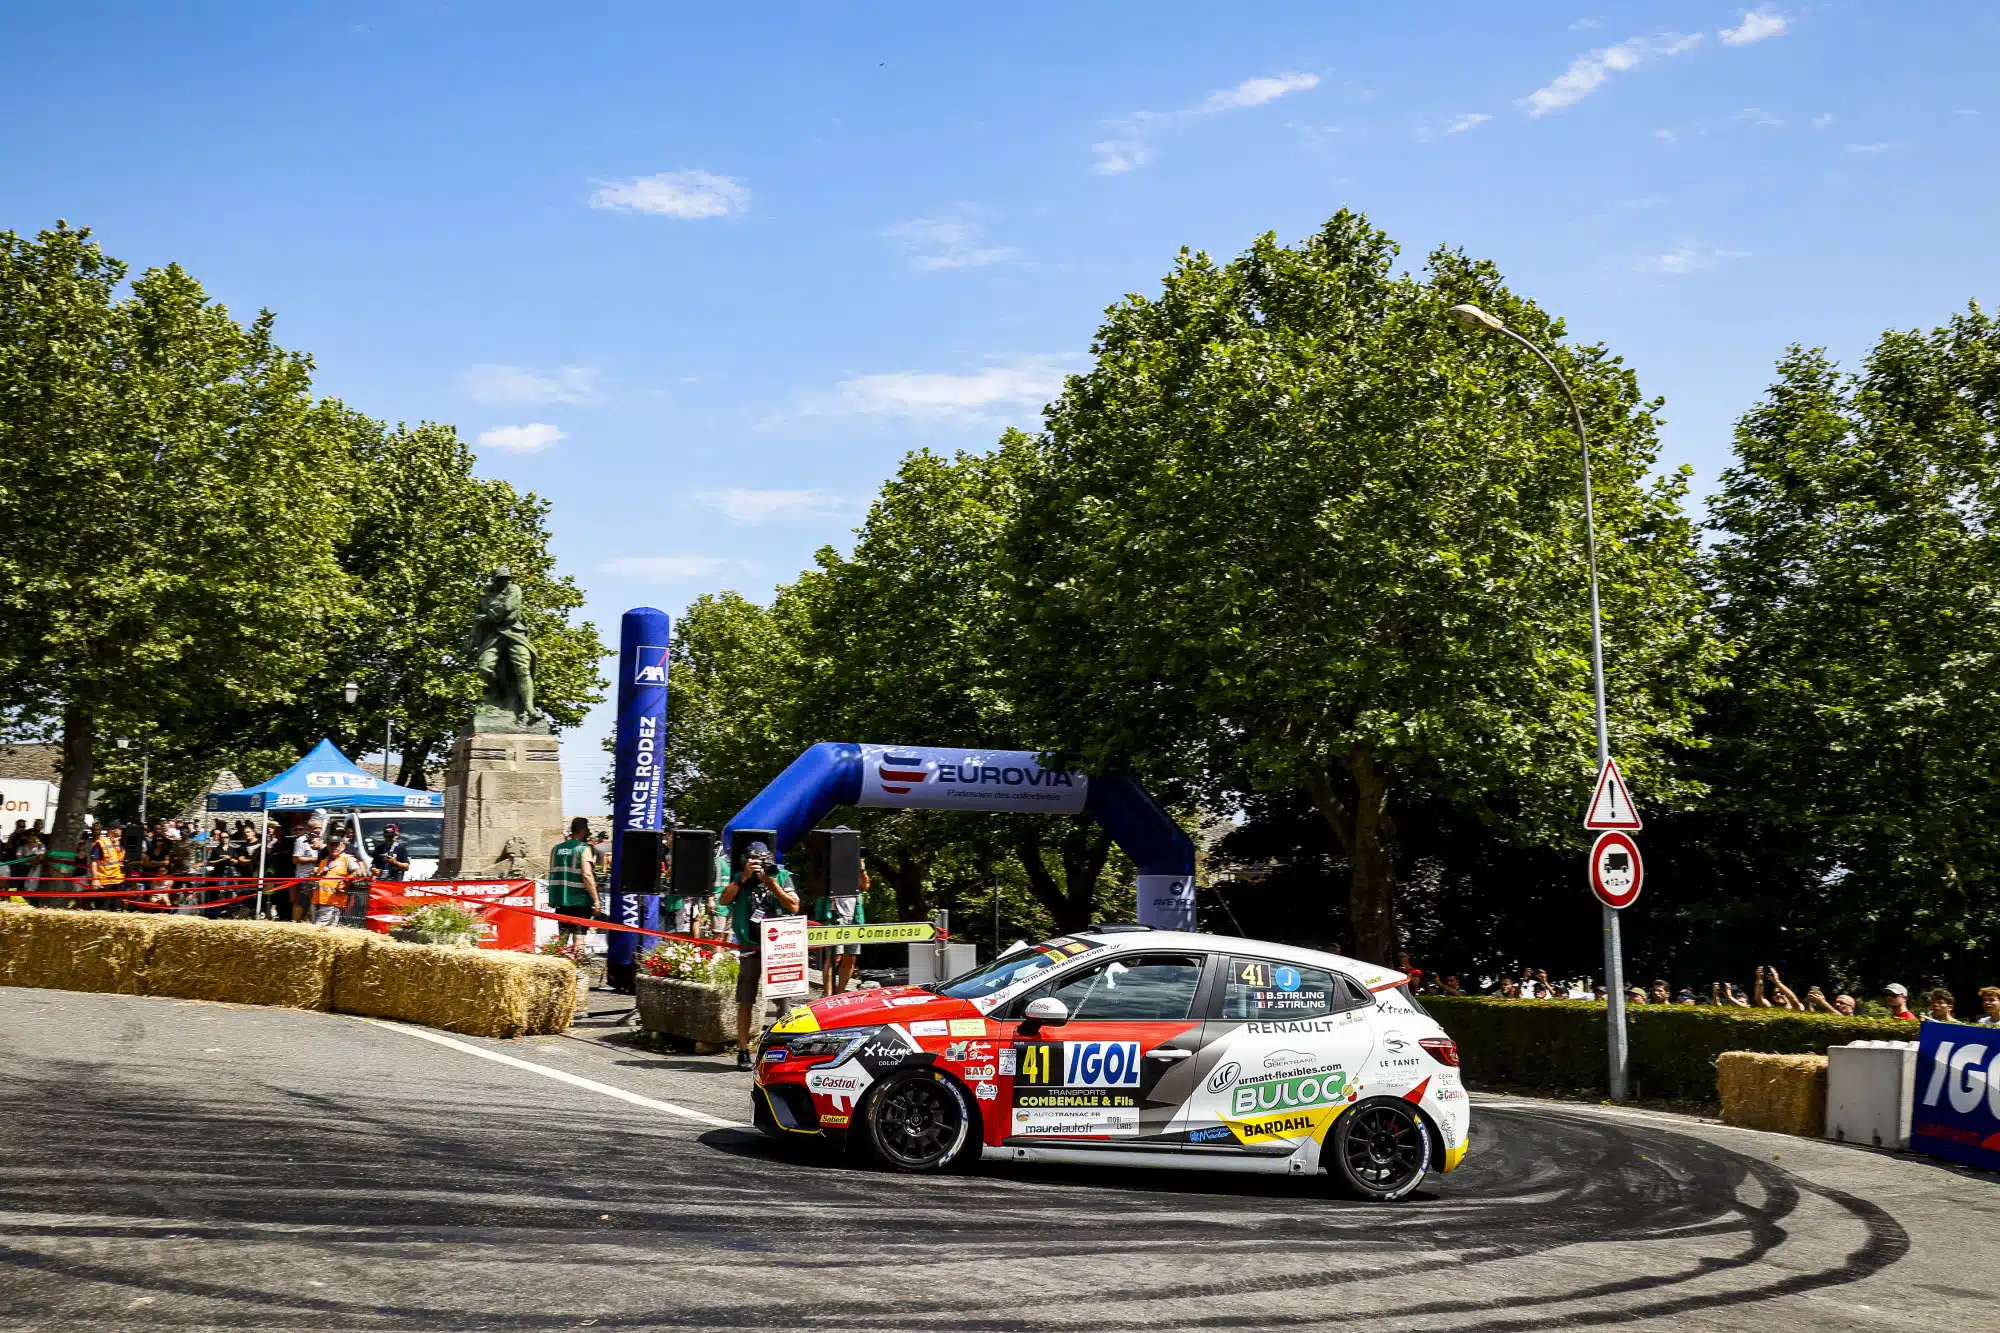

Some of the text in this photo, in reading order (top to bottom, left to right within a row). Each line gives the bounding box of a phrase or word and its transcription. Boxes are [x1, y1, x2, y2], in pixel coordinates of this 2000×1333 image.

[636, 666, 665, 682] AXA
[938, 764, 1073, 787] EUROVIA
[0, 799, 30, 811] on
[623, 894, 639, 928] AXA
[635, 716, 656, 776] RODEZ
[836, 929, 850, 939] de
[857, 927, 921, 938] Comencau
[1241, 964, 1264, 986] 41
[1283, 971, 1292, 986] J
[1376, 1001, 1416, 1015] X'treme
[1248, 1021, 1333, 1034] RENAULT
[864, 1042, 913, 1057] X'treme
[1022, 1045, 1050, 1084] 41
[1067, 1043, 1139, 1085] IGOL
[1393, 1058, 1420, 1067] TANET
[1238, 1063, 1342, 1085] urmatt-flexibles.com
[822, 1077, 856, 1089] Castrol
[1235, 1074, 1343, 1113] BULOC
[1019, 1096, 1098, 1107] COMBEMALE
[1102, 1096, 1111, 1106] &
[1025, 1123, 1094, 1134] maurelauto.fr
[1244, 1117, 1315, 1137] BARDAHL
